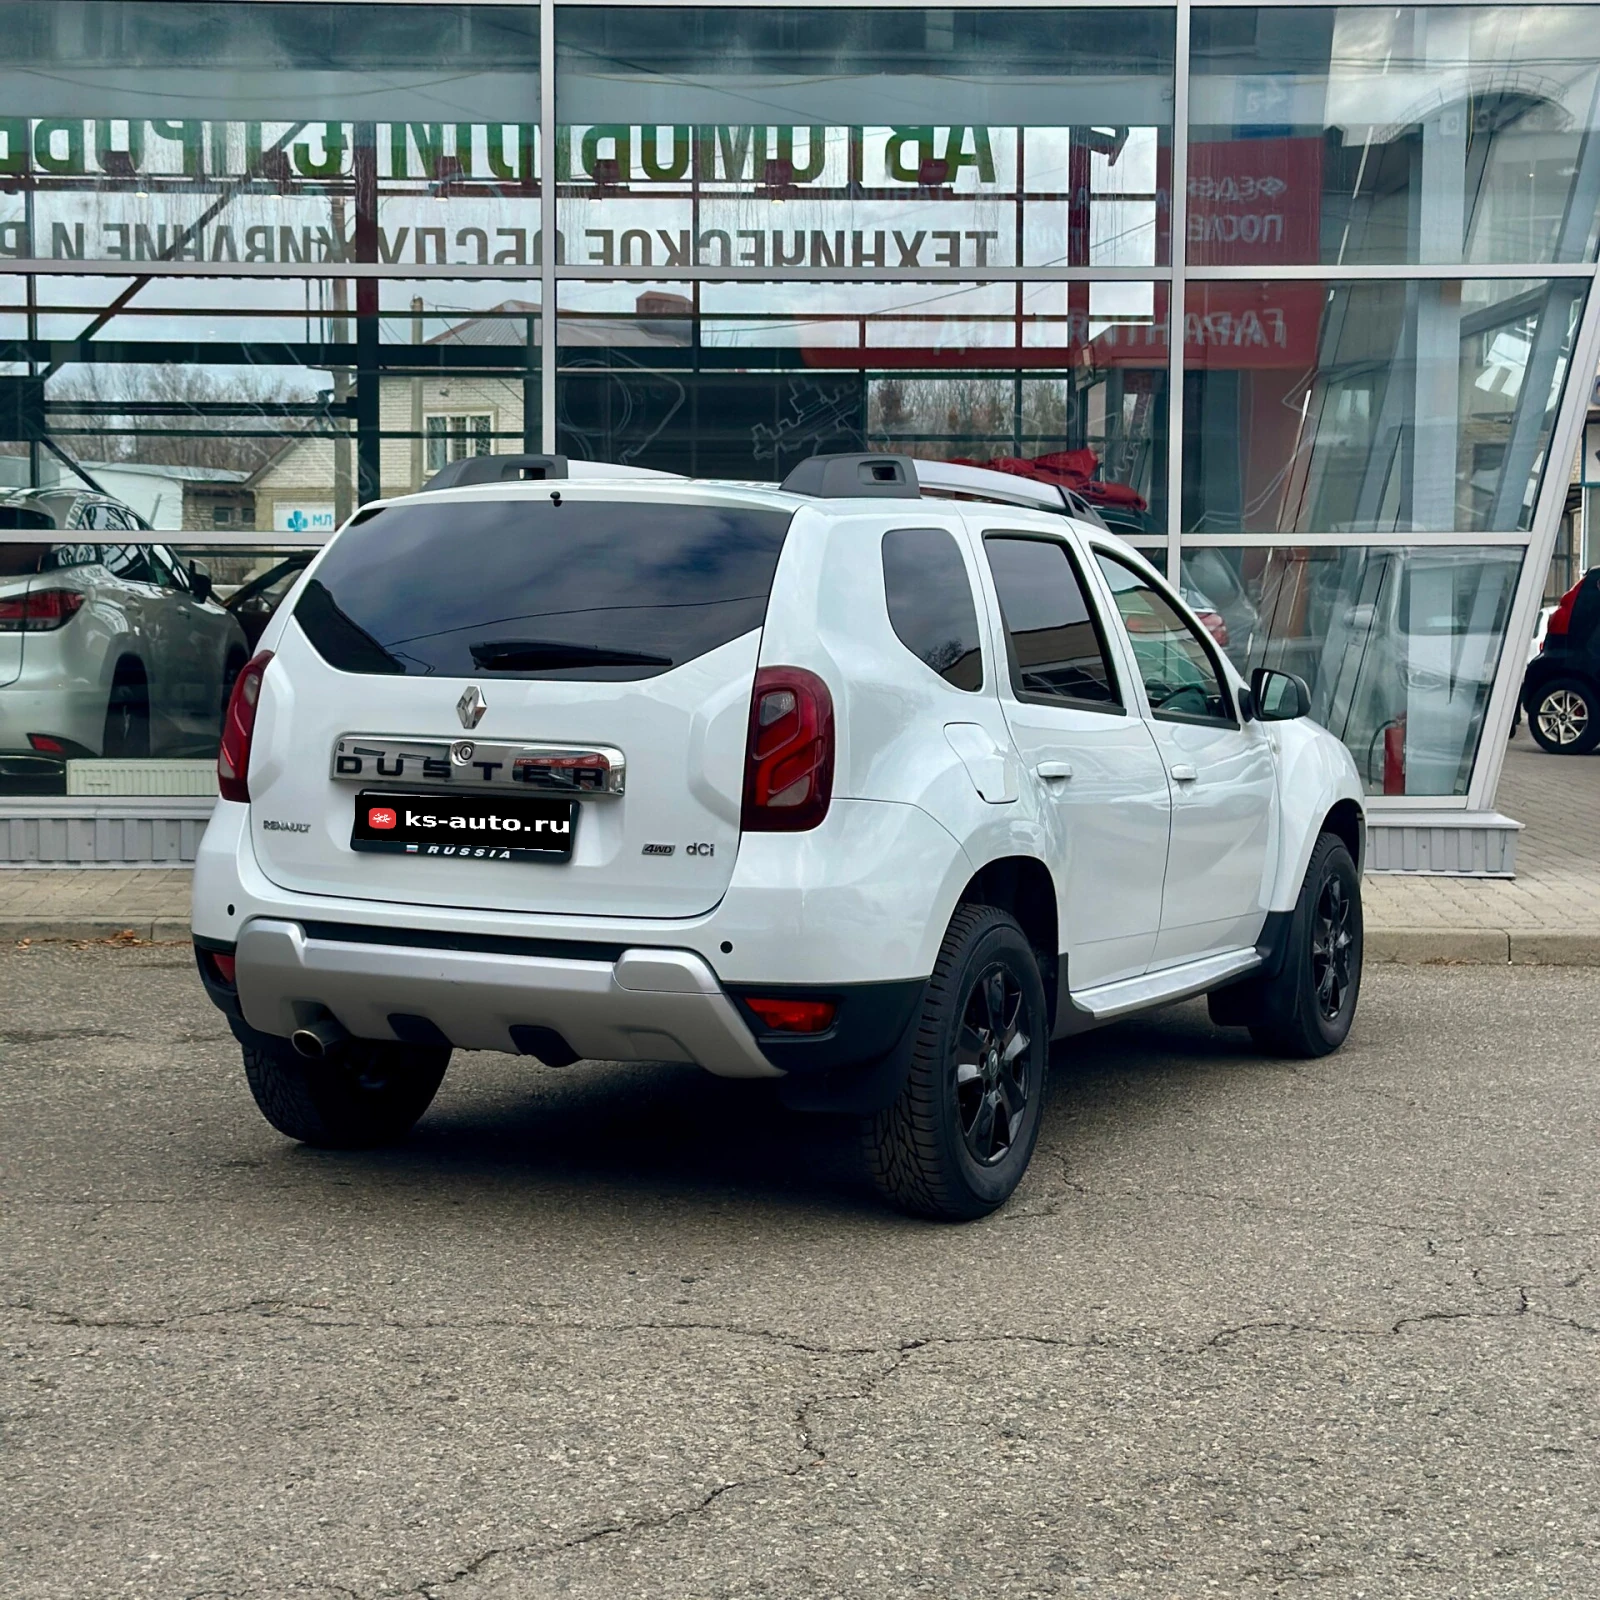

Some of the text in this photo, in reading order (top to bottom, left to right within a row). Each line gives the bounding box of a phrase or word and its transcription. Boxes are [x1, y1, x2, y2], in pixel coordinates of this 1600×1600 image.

[336, 755, 604, 787] DUSTER
[263, 819, 312, 834] RENAULT
[427, 844, 512, 859] RUSSIA
[643, 843, 674, 855] 4WD
